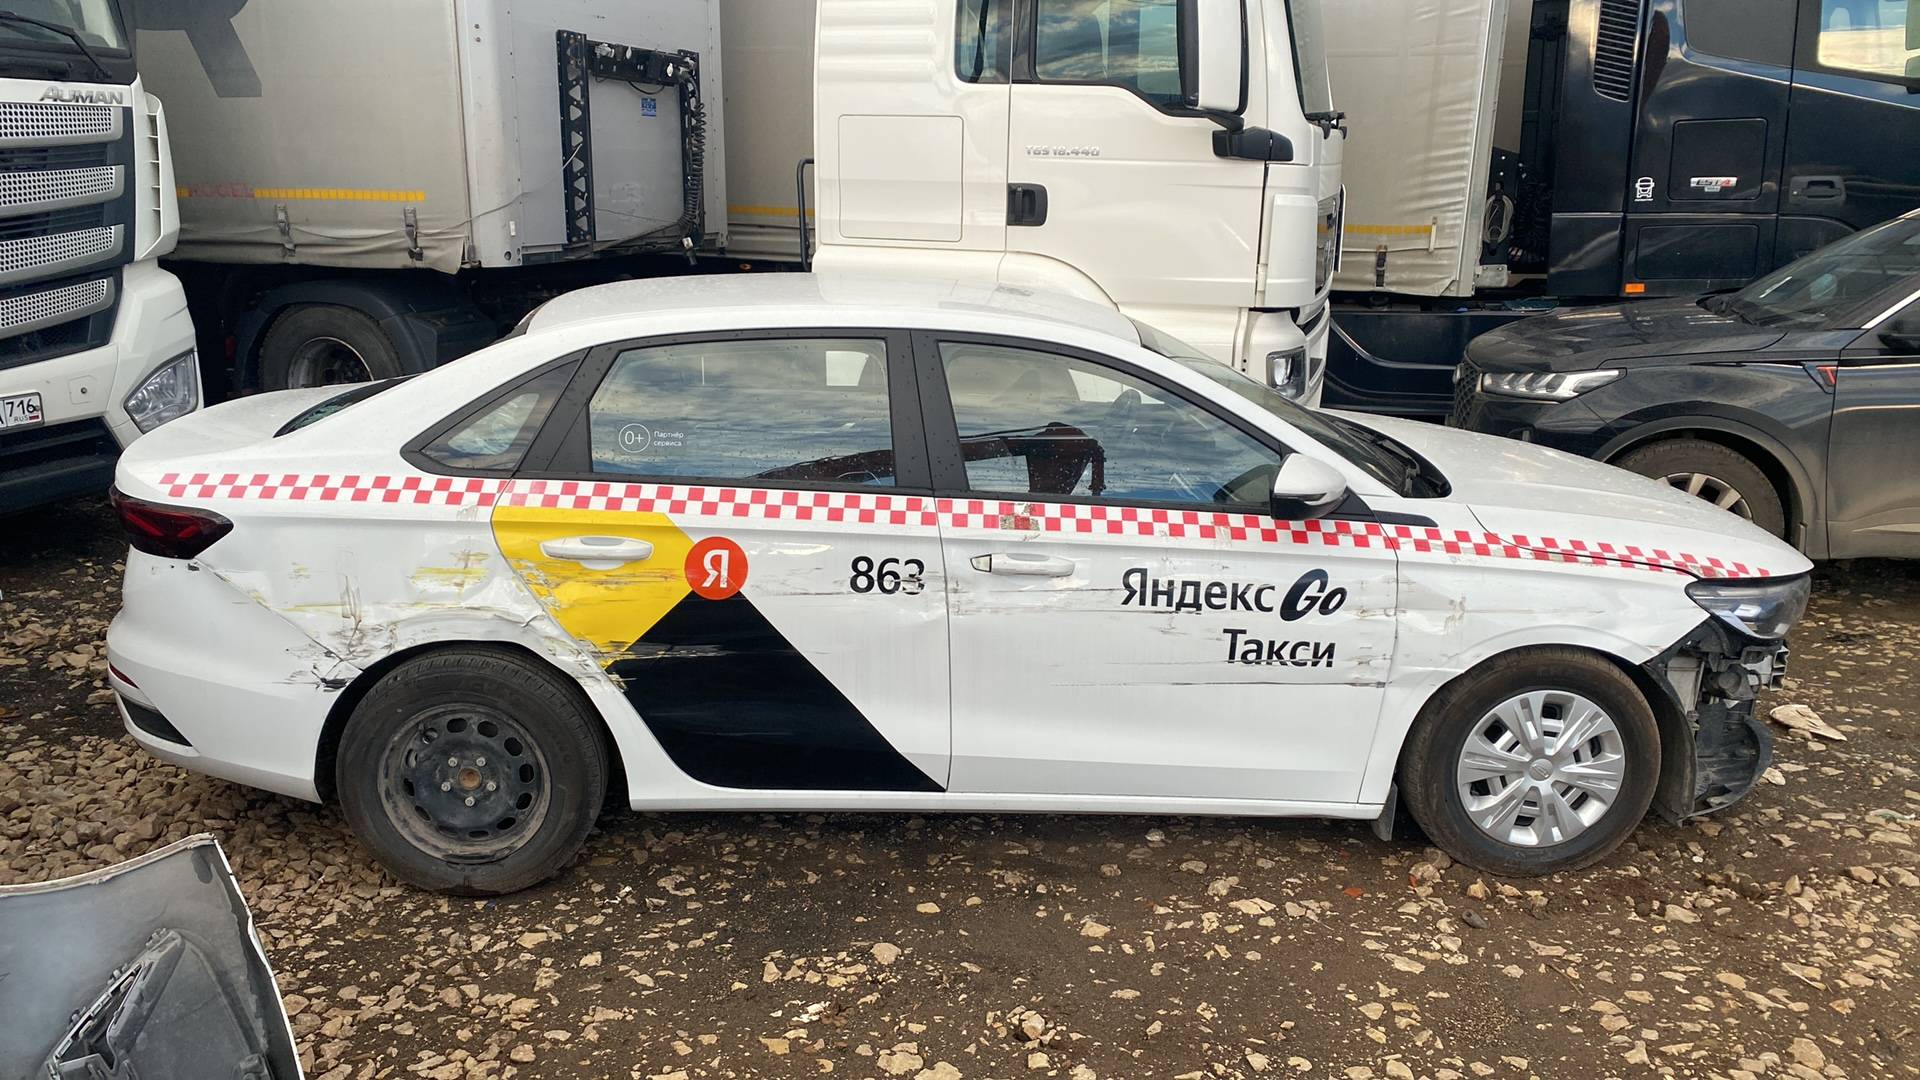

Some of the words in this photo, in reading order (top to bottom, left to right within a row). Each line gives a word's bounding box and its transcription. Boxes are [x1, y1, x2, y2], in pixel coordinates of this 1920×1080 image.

[39, 86, 123, 104] AUMAN
[702, 549, 729, 588] Я
[849, 556, 925, 595] 863
[1121, 567, 1276, 615] Яндекс
[1279, 568, 1348, 622] Go
[1222, 628, 1336, 668] Такси
